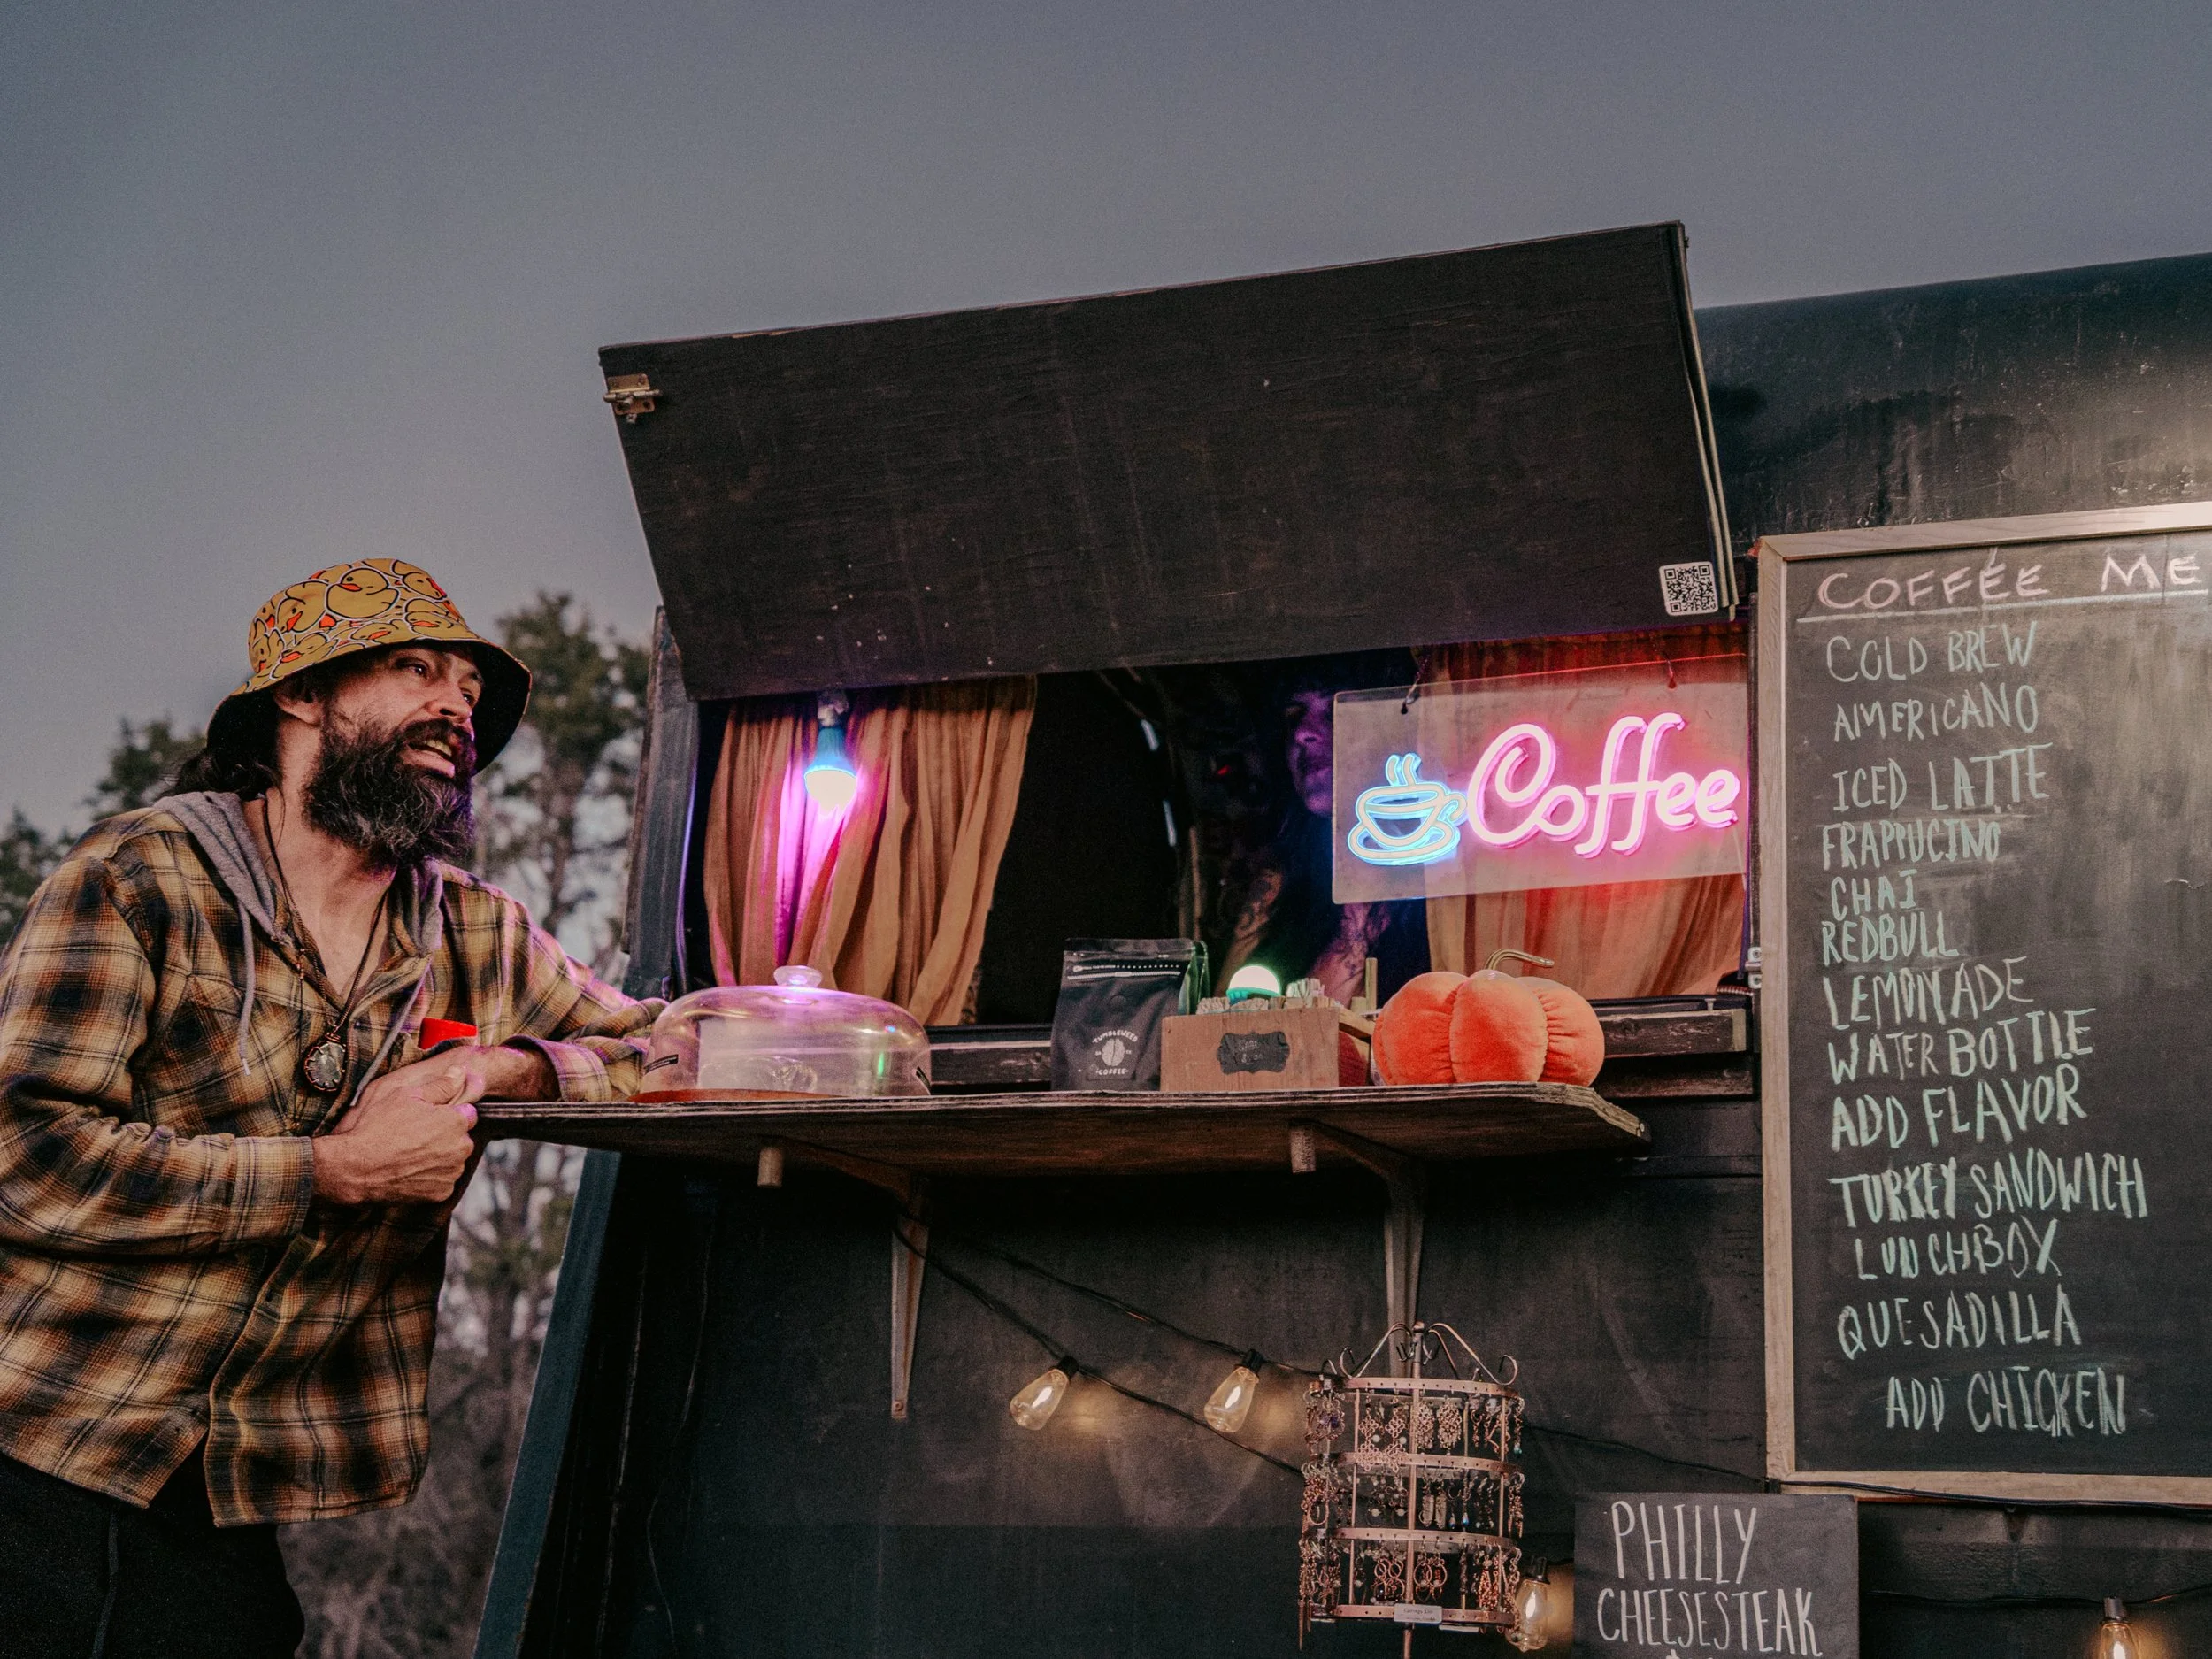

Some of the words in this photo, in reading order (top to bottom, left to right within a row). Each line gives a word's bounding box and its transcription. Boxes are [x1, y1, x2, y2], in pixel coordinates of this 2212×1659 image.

[2101, 552, 2202, 591] ME
[1826, 635, 1928, 682] COLD
[1948, 620, 2038, 673] BREW
[1834, 682, 2038, 741] AMERICANO
[1467, 712, 1740, 859] Coffee
[1833, 758, 1907, 811] ICED
[1930, 742, 2053, 810] LATTE
[1822, 818, 2001, 871] FRAPPUCINO
[1831, 869, 1918, 921] CHAI
[1821, 911, 1959, 966] REDBULL
[1823, 956, 2034, 1030] LEMONADE
[1092, 1030, 1139, 1043] TUMBLEWEED
[1828, 1032, 1939, 1085] WATER
[1947, 1008, 2096, 1077] BOTTLE
[1832, 1094, 1909, 1151] ADD
[1922, 1063, 2087, 1147] FLAVOR
[1827, 1157, 1956, 1227] TURKEY
[1970, 1148, 2148, 1219] SANDWICH
[1855, 1216, 2062, 1280] LUNCHBOX
[1838, 1283, 2082, 1360] QUESADILLA
[1886, 1376, 1947, 1432] ADD
[1967, 1365, 2126, 1438] CHICKEN
[1611, 1500, 1757, 1585] PHILLY
[1597, 1587, 1823, 1658] CHEESESTEAK
